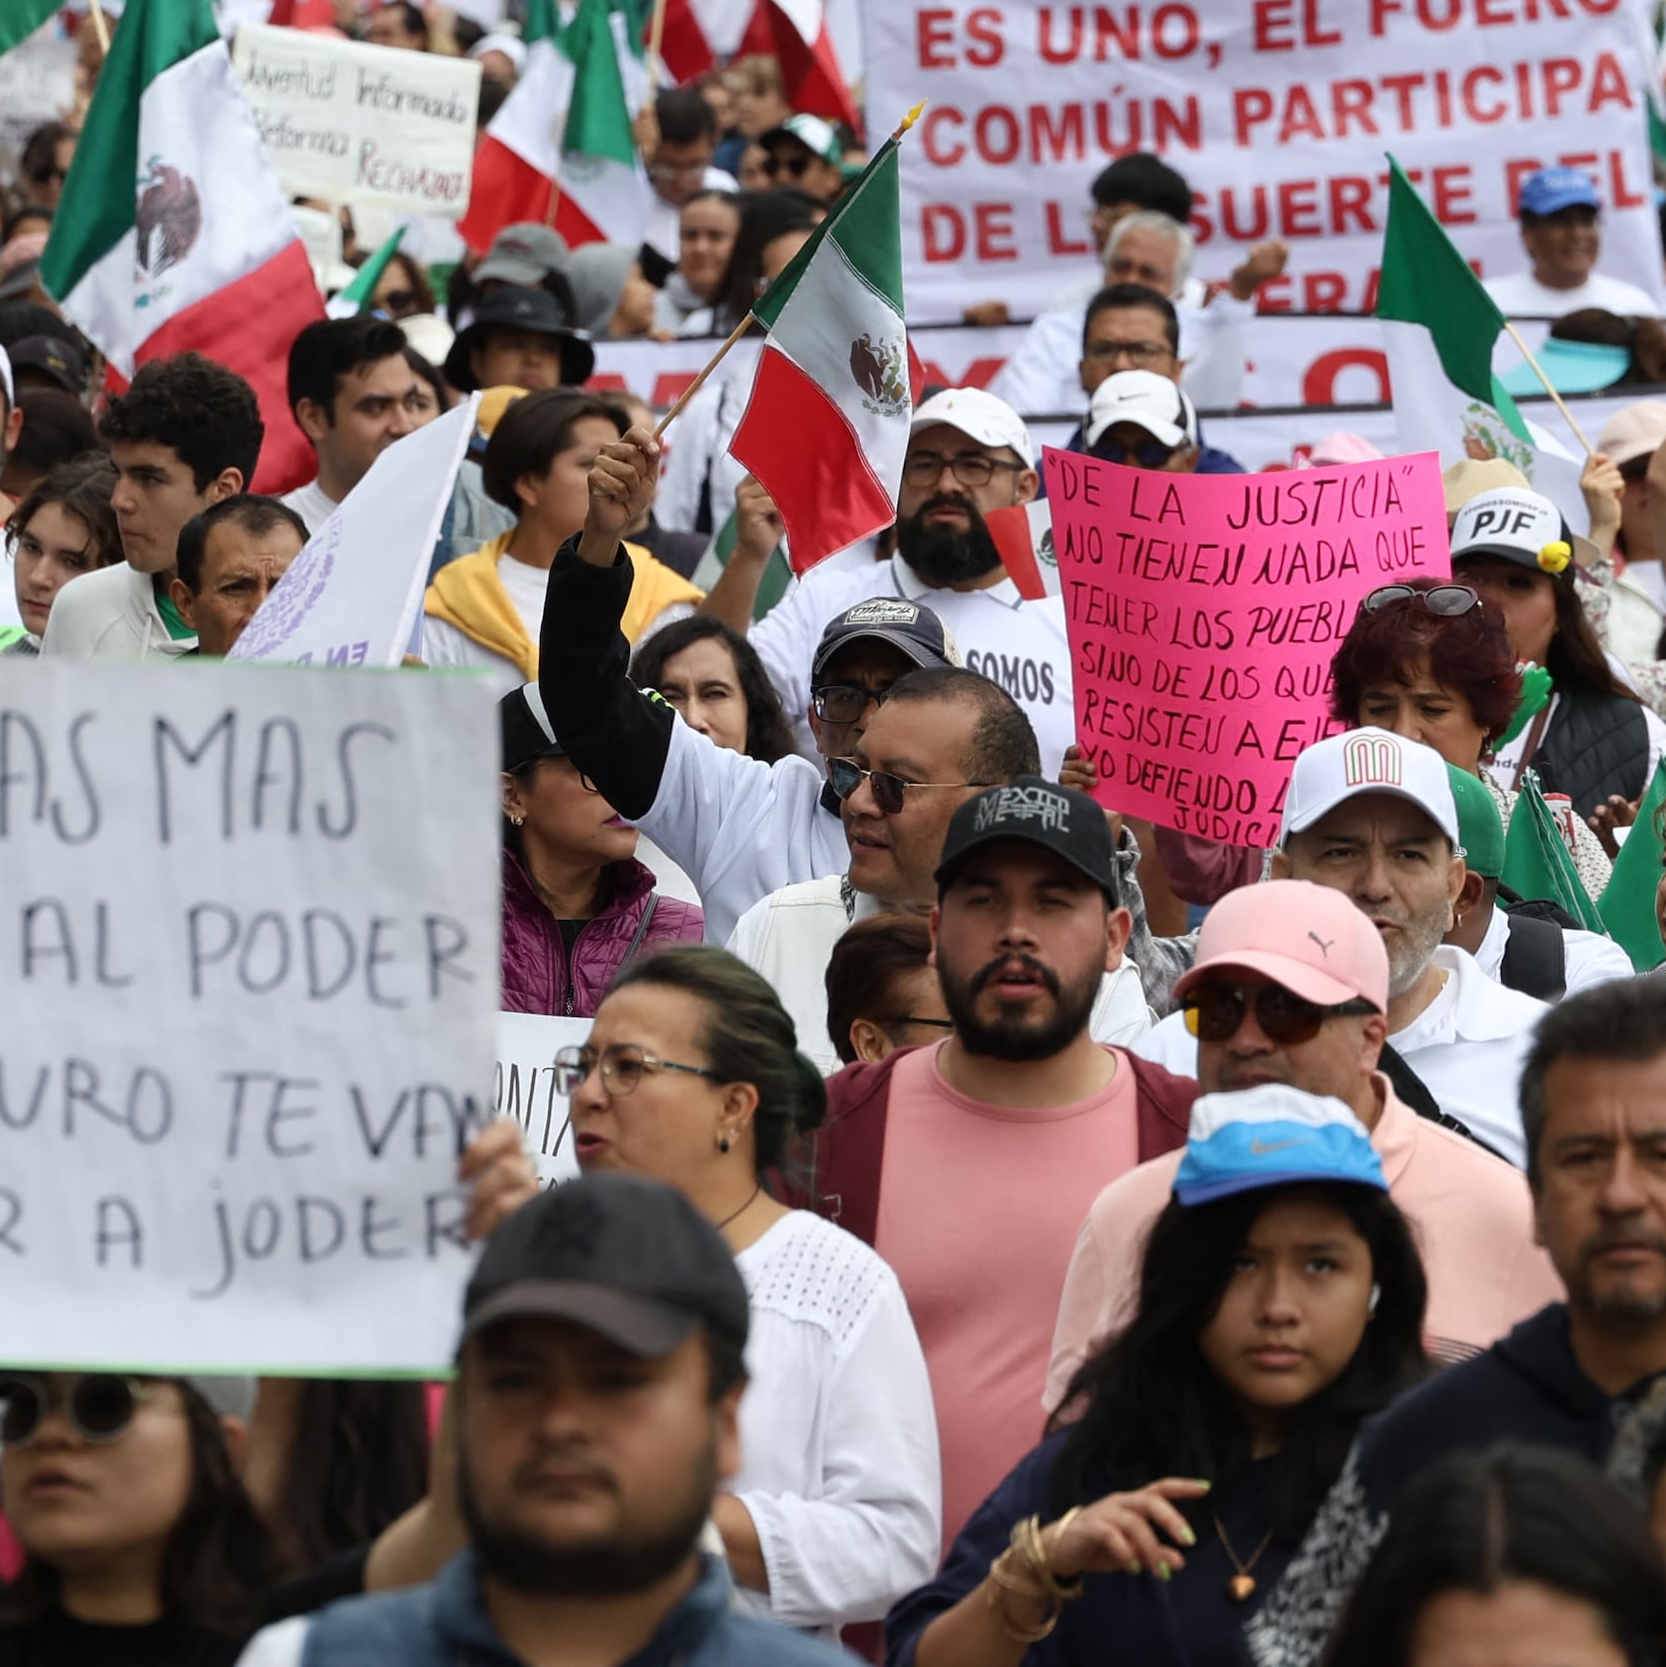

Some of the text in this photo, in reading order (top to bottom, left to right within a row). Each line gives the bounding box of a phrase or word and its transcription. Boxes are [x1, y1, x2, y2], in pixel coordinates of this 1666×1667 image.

[918, 9, 1004, 68] ES
[1040, 2, 1222, 70] UNO,
[923, 52, 1634, 166] COMÚN PARTICIPA
[920, 203, 1017, 263] DE
[1045, 198, 1098, 255] L
[1129, 476, 1186, 526] LA
[1470, 509, 1536, 540] PJF
[1065, 522, 1426, 587] NO TIENEN NADA QUE
[1070, 580, 1354, 651] TEMER LOS PUEBL
[966, 649, 1054, 705] SOMOS
[1080, 640, 1141, 686] SINO
[1151, 659, 1190, 699] DE
[1199, 665, 1260, 700] LOS
[1083, 688, 1227, 754] RESISTEN
[1234, 719, 1265, 759] A
[152, 705, 397, 846] MAS
[1080, 738, 1116, 780] YO
[1125, 752, 1257, 815] DEFIENDO
[1173, 806, 1277, 849] JUDICI
[21, 896, 134, 989] AL
[187, 900, 479, 1012] PODER
[220, 1071, 320, 1159] TE
[96, 1195, 142, 1268] A
